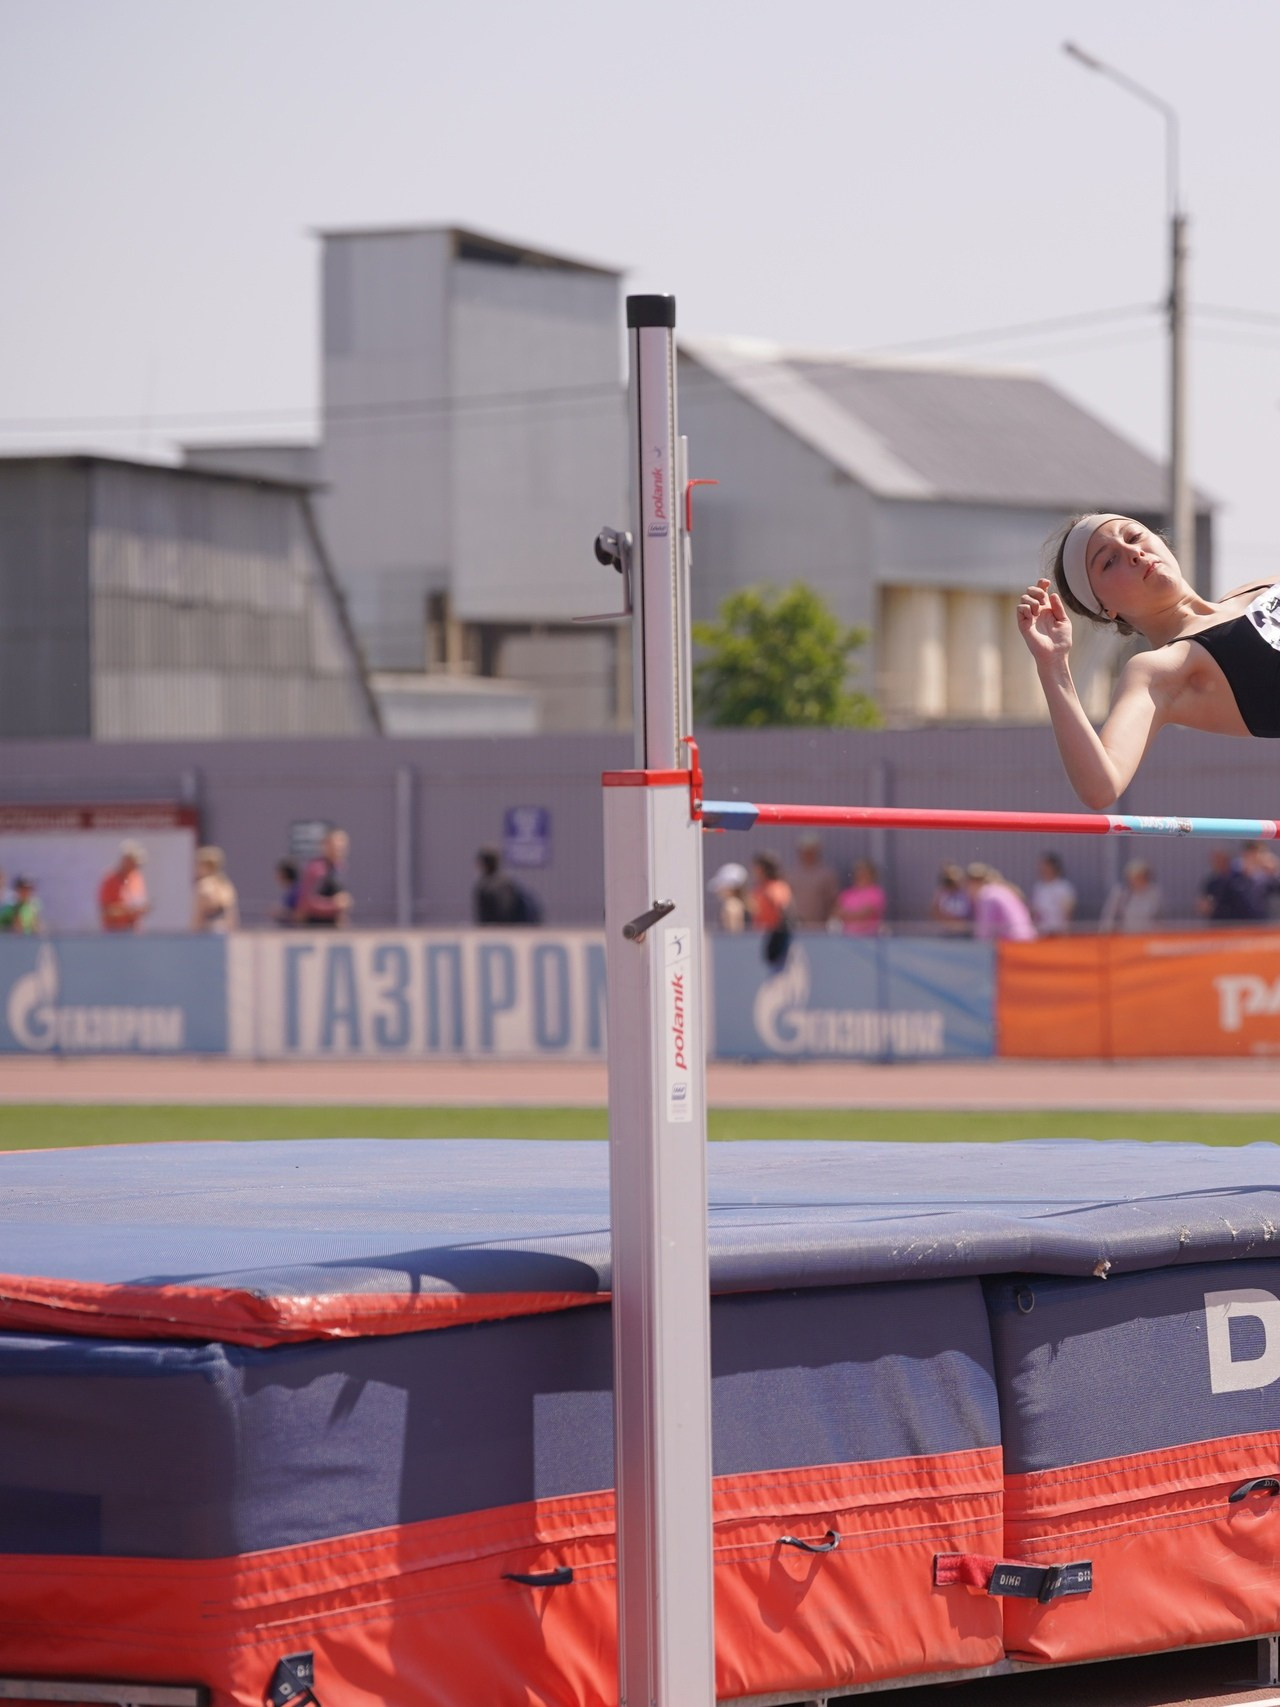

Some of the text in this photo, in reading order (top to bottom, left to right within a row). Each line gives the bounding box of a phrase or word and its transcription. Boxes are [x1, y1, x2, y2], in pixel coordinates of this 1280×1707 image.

[652, 467, 666, 519] polanik
[671, 973, 687, 1070] polanik
[1000, 1574, 1021, 1587] DIMA
